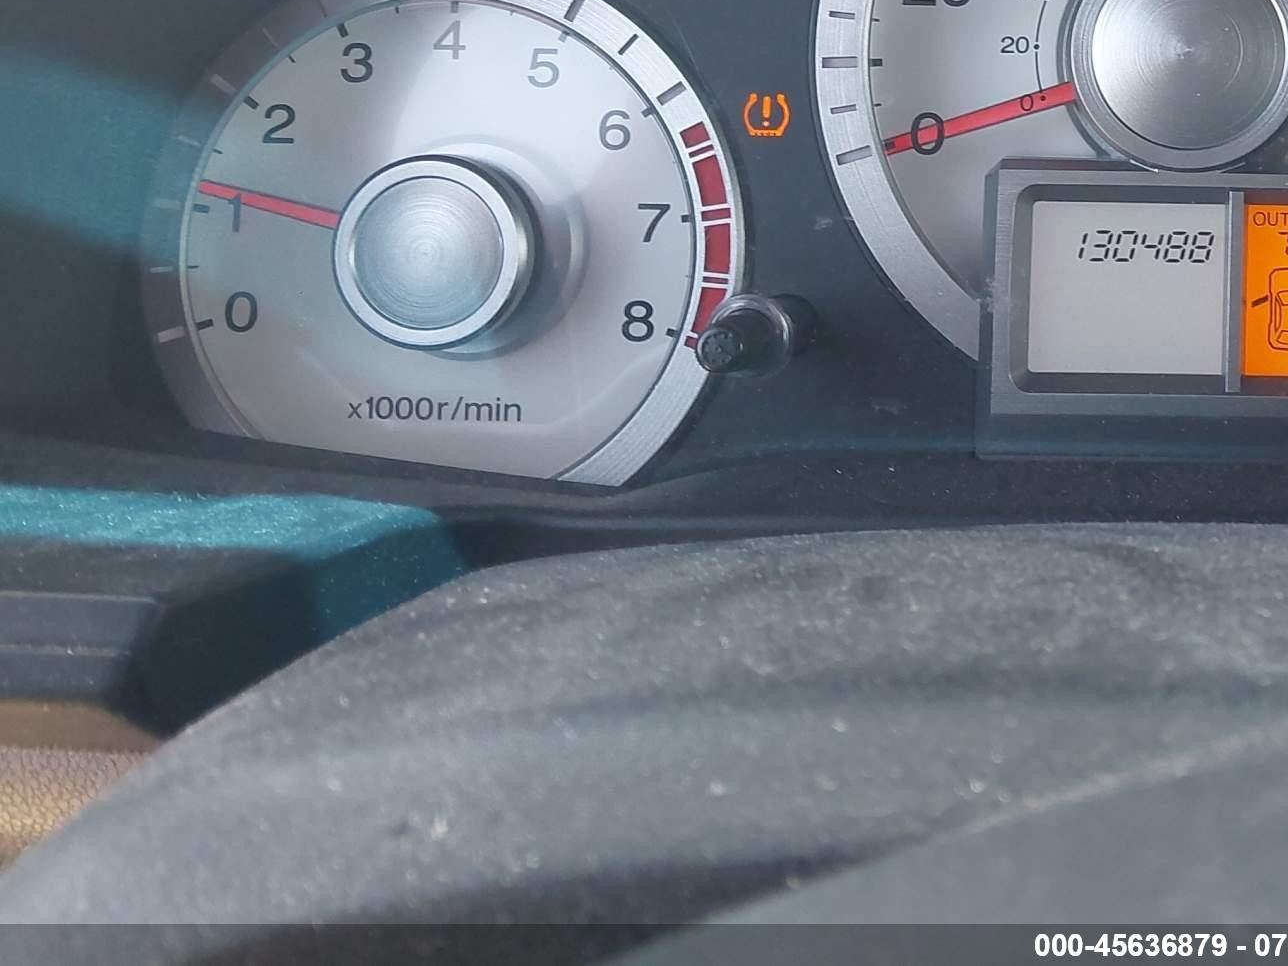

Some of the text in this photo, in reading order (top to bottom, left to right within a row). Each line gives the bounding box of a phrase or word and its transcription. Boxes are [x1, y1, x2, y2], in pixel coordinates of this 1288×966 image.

[434, 21, 465, 59] 4
[1001, 37, 1028, 53] 20
[341, 43, 373, 83] 3
[527, 48, 559, 88] 5
[1020, 95, 1033, 111] 0
[263, 104, 295, 144] 2
[600, 110, 631, 150] 6
[910, 112, 944, 155] 0
[230, 194, 242, 233] 1
[637, 204, 670, 242] 7
[1078, 231, 1214, 263] 130488
[225, 291, 258, 332] 0
[621, 300, 654, 341] 8
[348, 396, 522, 423] x1000r/min
